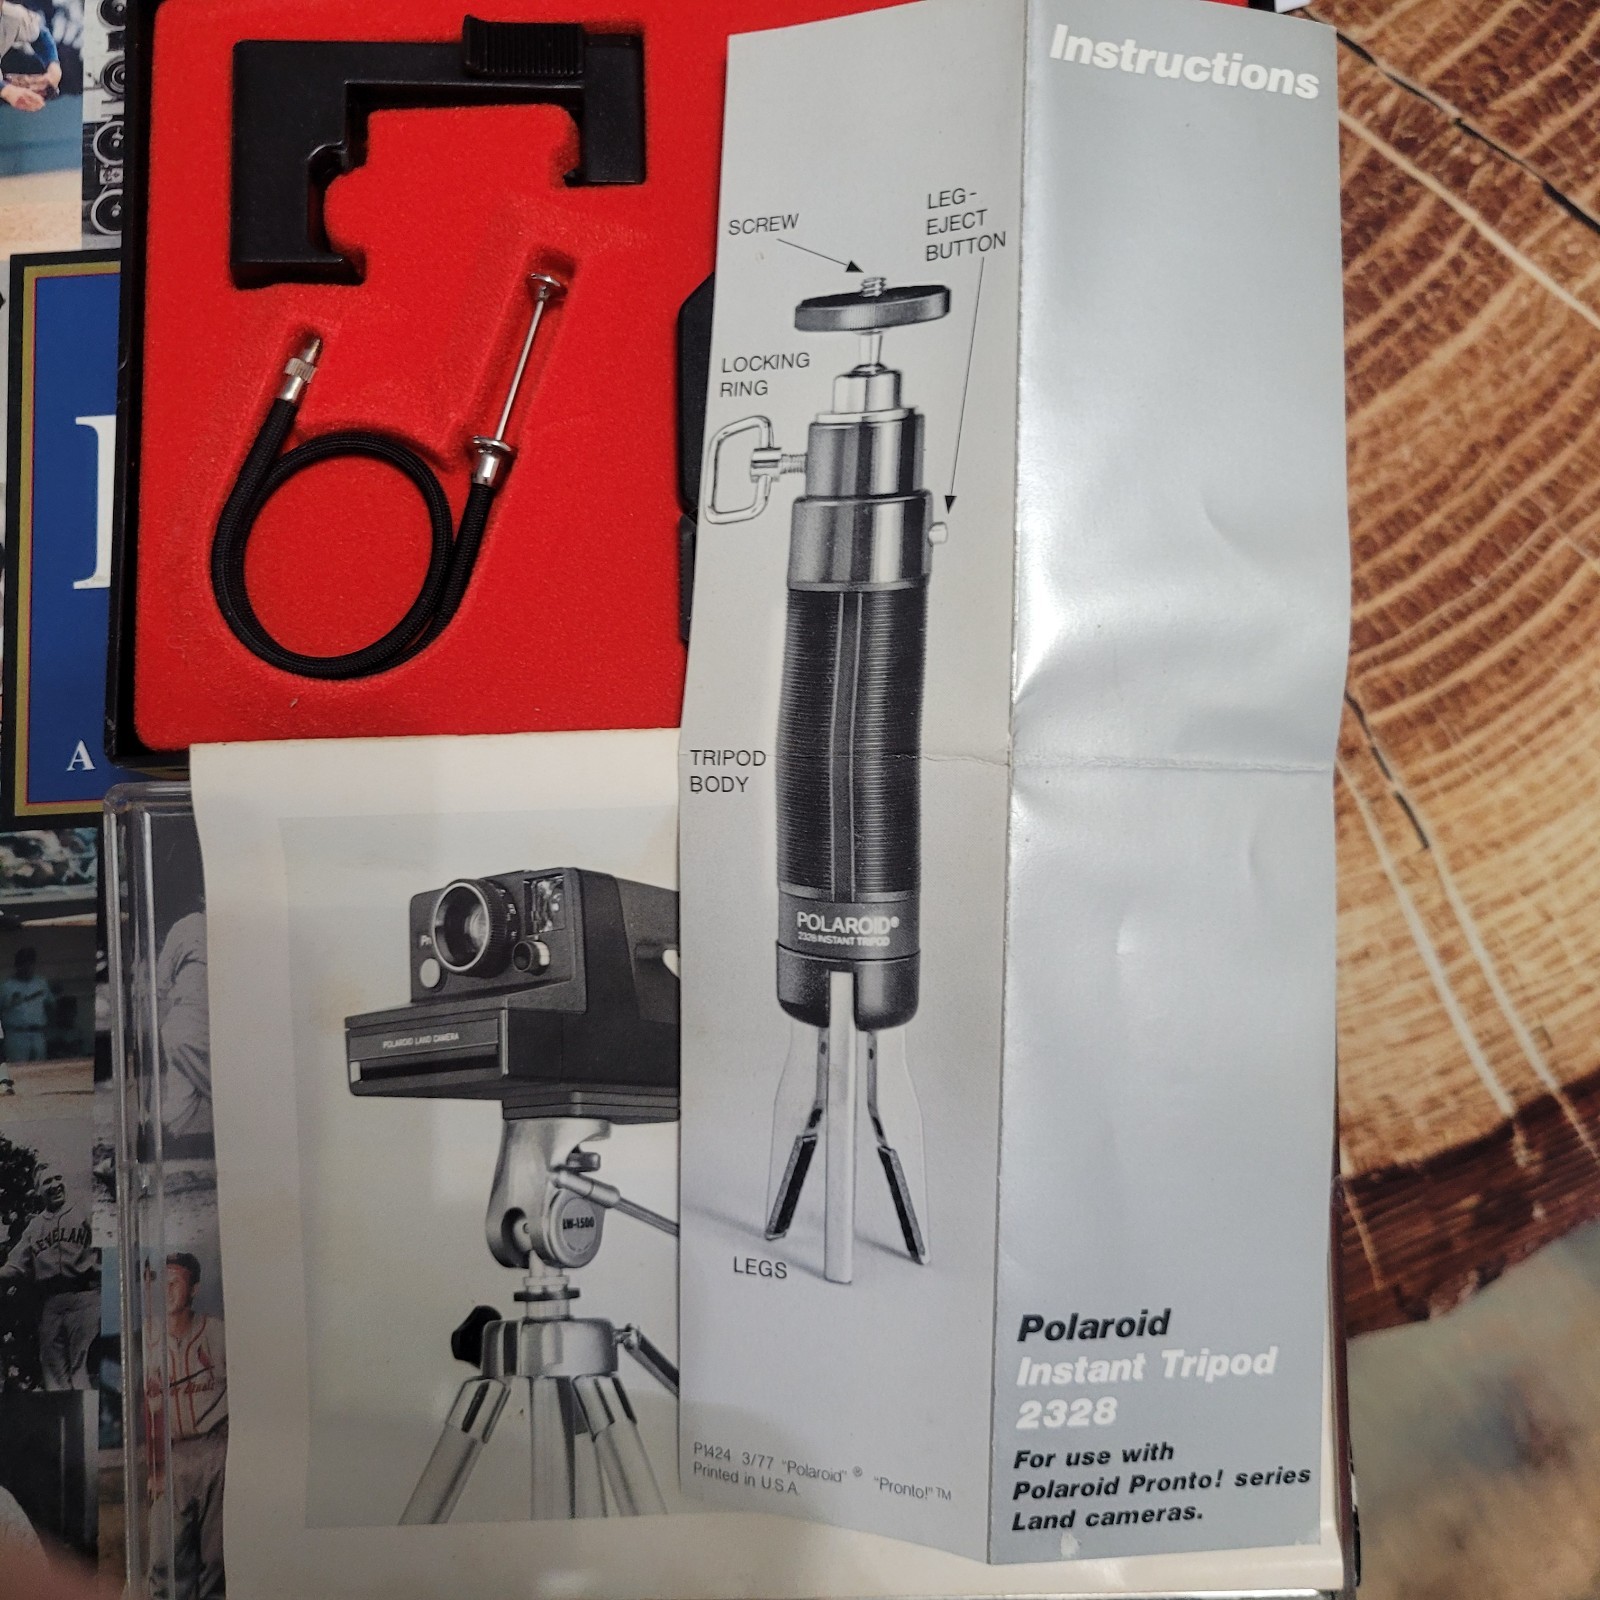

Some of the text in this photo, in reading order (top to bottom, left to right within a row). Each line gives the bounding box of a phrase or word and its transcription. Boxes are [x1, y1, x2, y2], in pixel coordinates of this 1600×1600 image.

[1049, 23, 1320, 100] Instructions
[927, 187, 977, 209] LEG-
[728, 213, 800, 236] SCREW
[926, 209, 988, 236] EJECT
[925, 231, 1007, 262] BUTTON
[721, 352, 811, 374] LOCKING
[719, 379, 769, 398] RING
[66, 740, 96, 771] A
[690, 749, 766, 767] TRIPOD
[690, 775, 749, 793] BODY
[733, 1255, 788, 1280] LEGS
[1017, 1308, 1172, 1341] Polaroid
[1016, 1346, 1279, 1386] Instant Tripod
[1015, 1396, 1119, 1430] 2328
[742, 1451, 775, 1469] 3/77
[1013, 1441, 1175, 1469] For use with
[693, 1461, 740, 1484] Printed
[744, 1472, 756, 1488] in
[1012, 1466, 1312, 1501] Polaroid Pronto! series
[1011, 1505, 1204, 1532] Land cameras.
